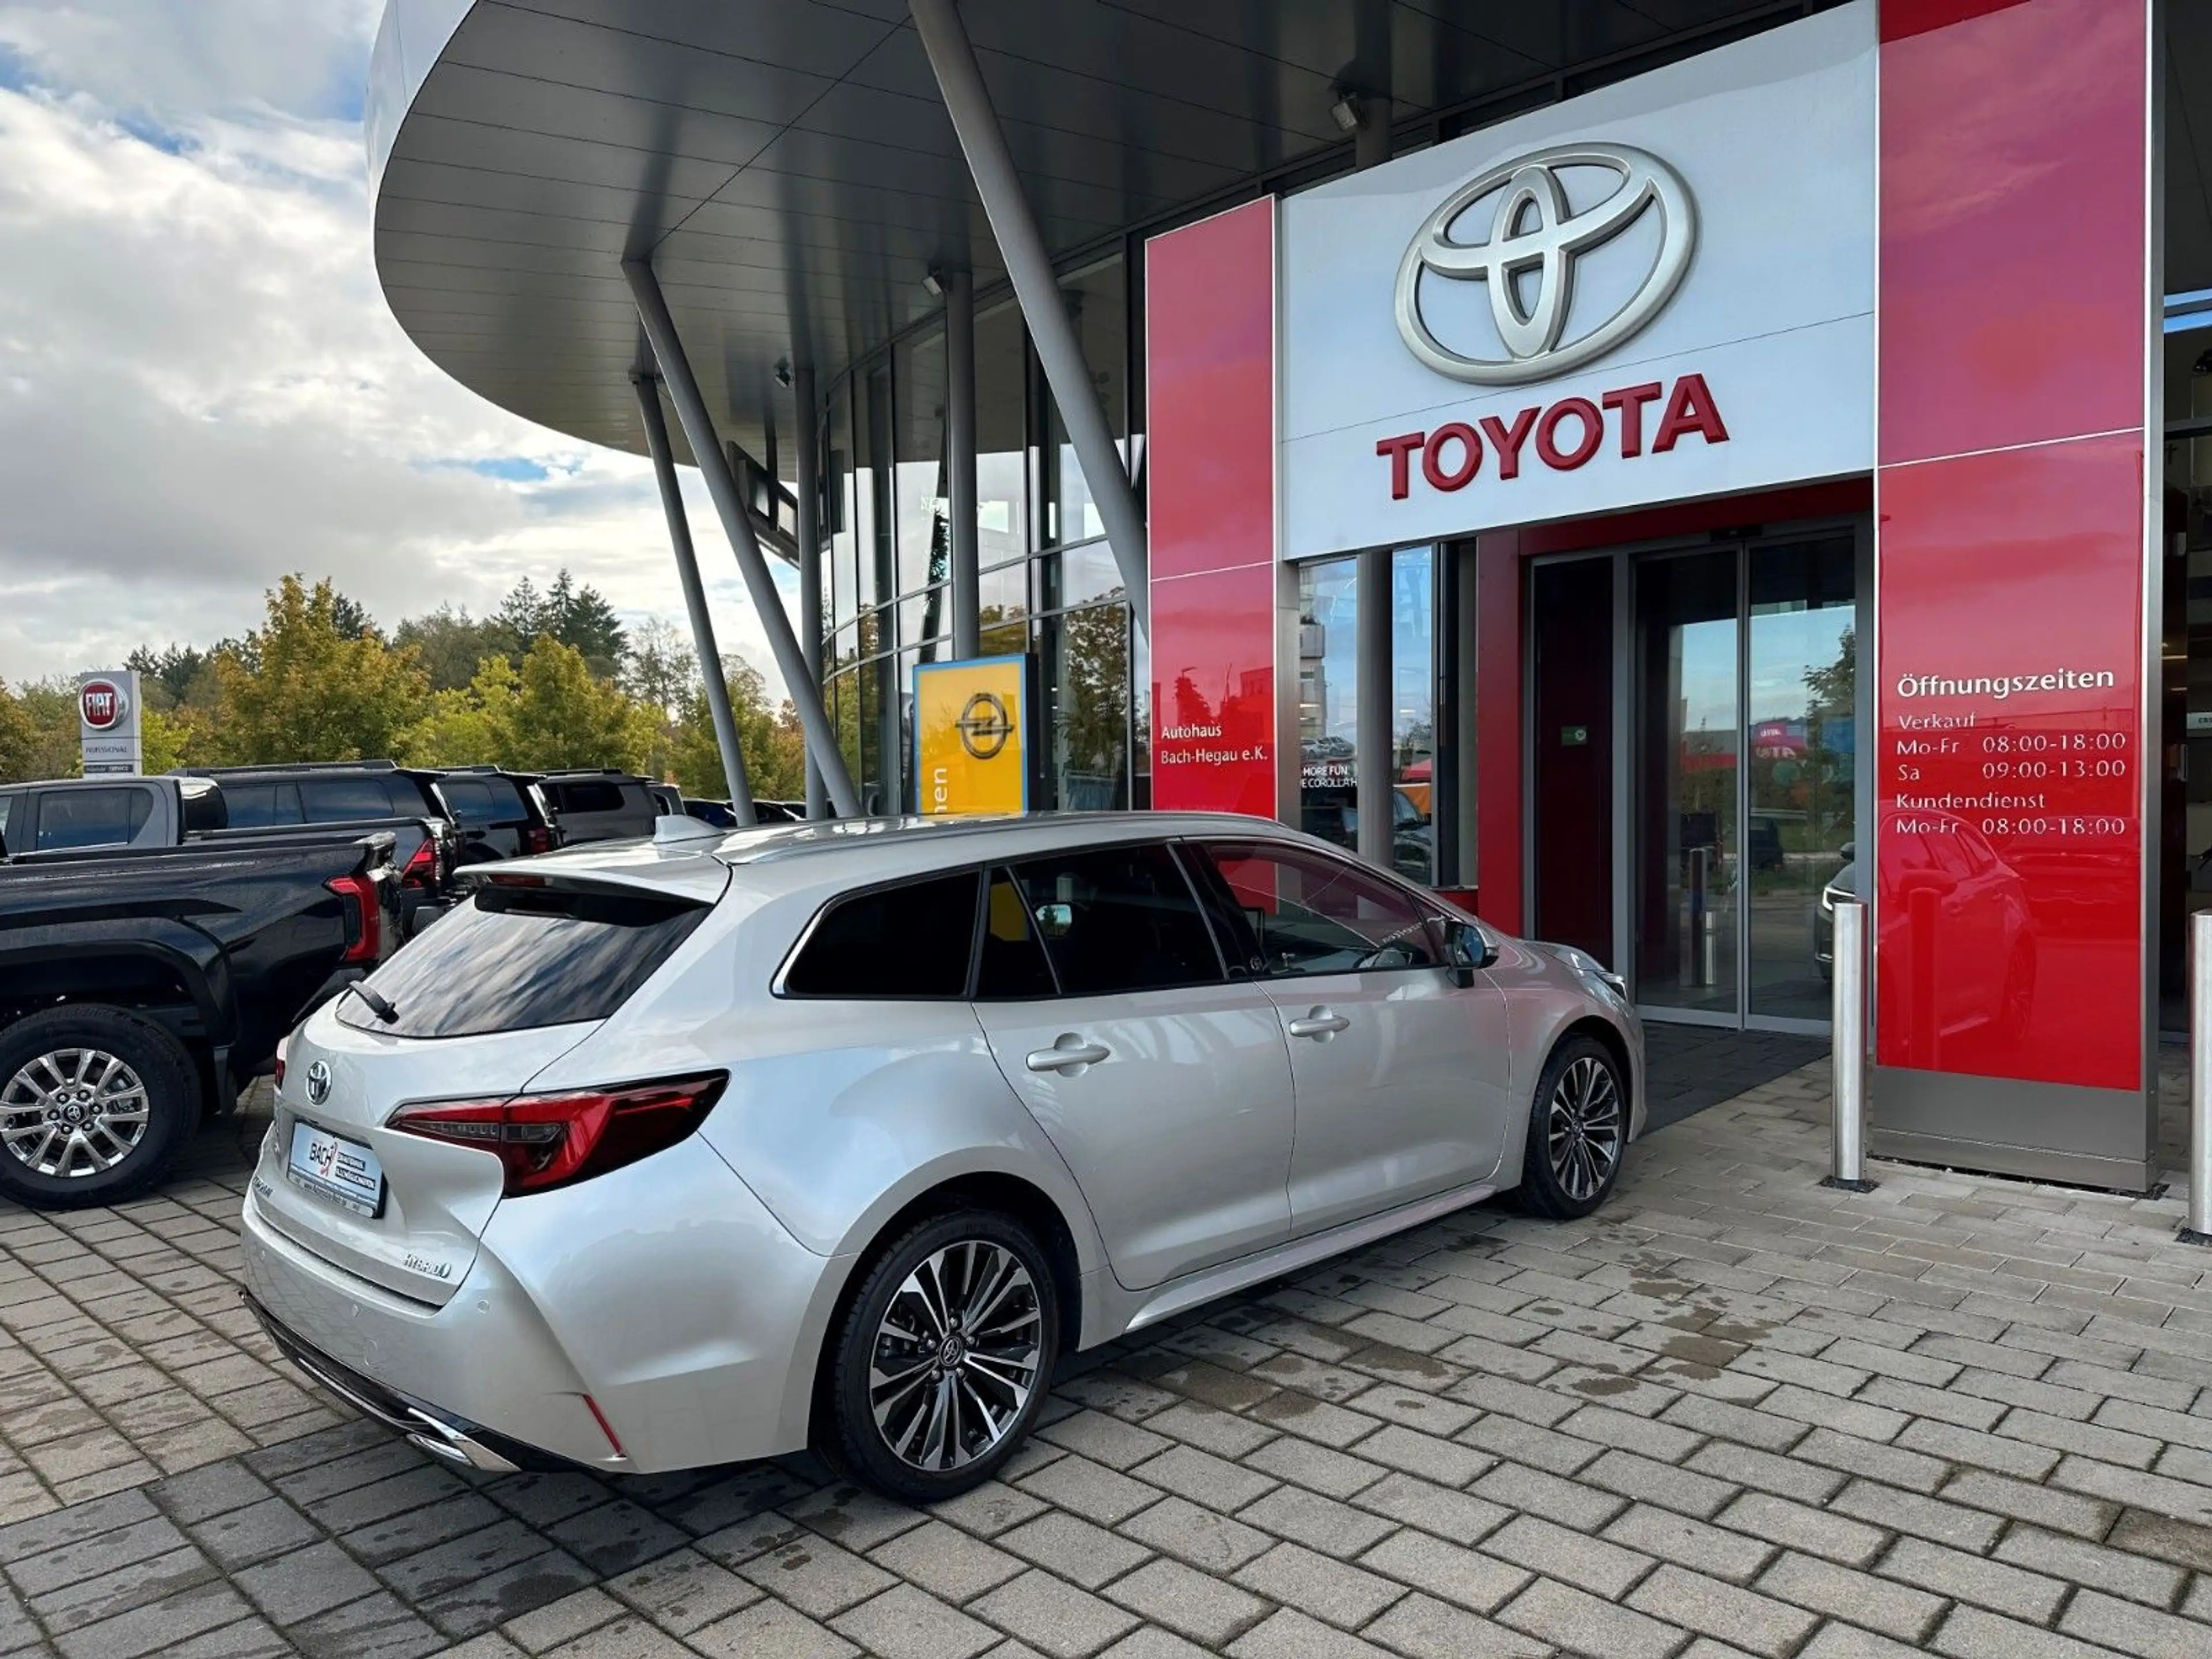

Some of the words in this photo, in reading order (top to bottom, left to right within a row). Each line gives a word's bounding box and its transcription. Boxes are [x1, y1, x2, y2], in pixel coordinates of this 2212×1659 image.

[1377, 373, 1730, 499] TOYOTA
[1897, 668, 2114, 699] Öffnungszeiten
[85, 692, 113, 717] FIAT
[1161, 723, 1222, 739] Autohaus
[1899, 713, 1976, 730] Verkauf
[1896, 737, 1959, 755] Mo-Fr
[1982, 732, 2126, 753] 08:00-18:00
[1161, 748, 1237, 766] Bach-Hegau
[1241, 745, 1267, 760] e.K.
[1329, 765, 1347, 775] FUN
[1898, 764, 1921, 781] Sa
[1982, 760, 2126, 779] 09:00-13:00
[1896, 792, 2046, 809] Kundendienst
[1896, 818, 1959, 834] Mo-Fr
[1982, 817, 2125, 835] 08:00-18:00
[309, 1142, 332, 1167] BACH
